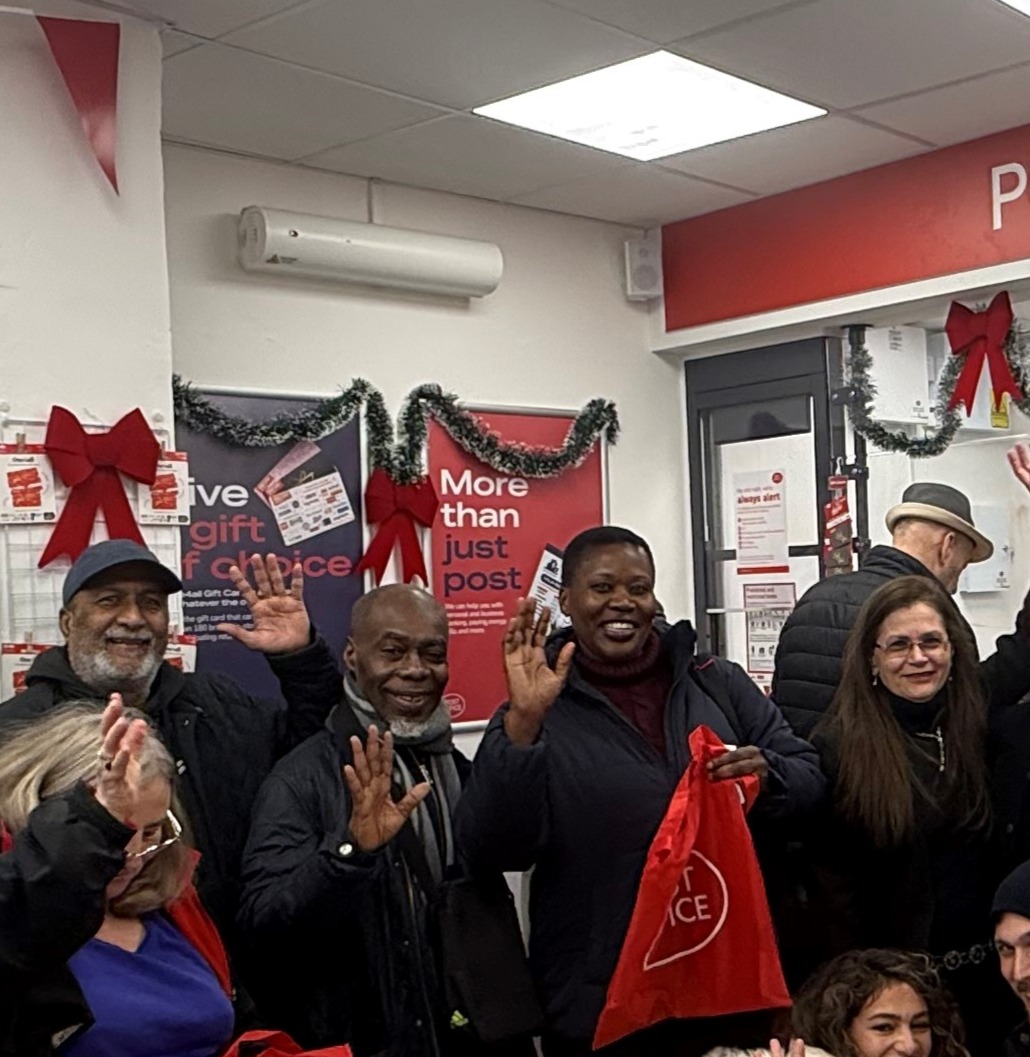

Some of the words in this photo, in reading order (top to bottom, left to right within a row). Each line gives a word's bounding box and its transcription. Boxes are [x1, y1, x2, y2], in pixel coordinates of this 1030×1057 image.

[188, 477, 249, 507] ive
[440, 469, 529, 498] More
[440, 501, 520, 528] than
[189, 514, 266, 550] gift
[442, 534, 508, 565] just
[182, 551, 200, 580] f
[223, 588, 240, 597] Car
[444, 567, 522, 597] post
[667, 894, 712, 927] ICE
